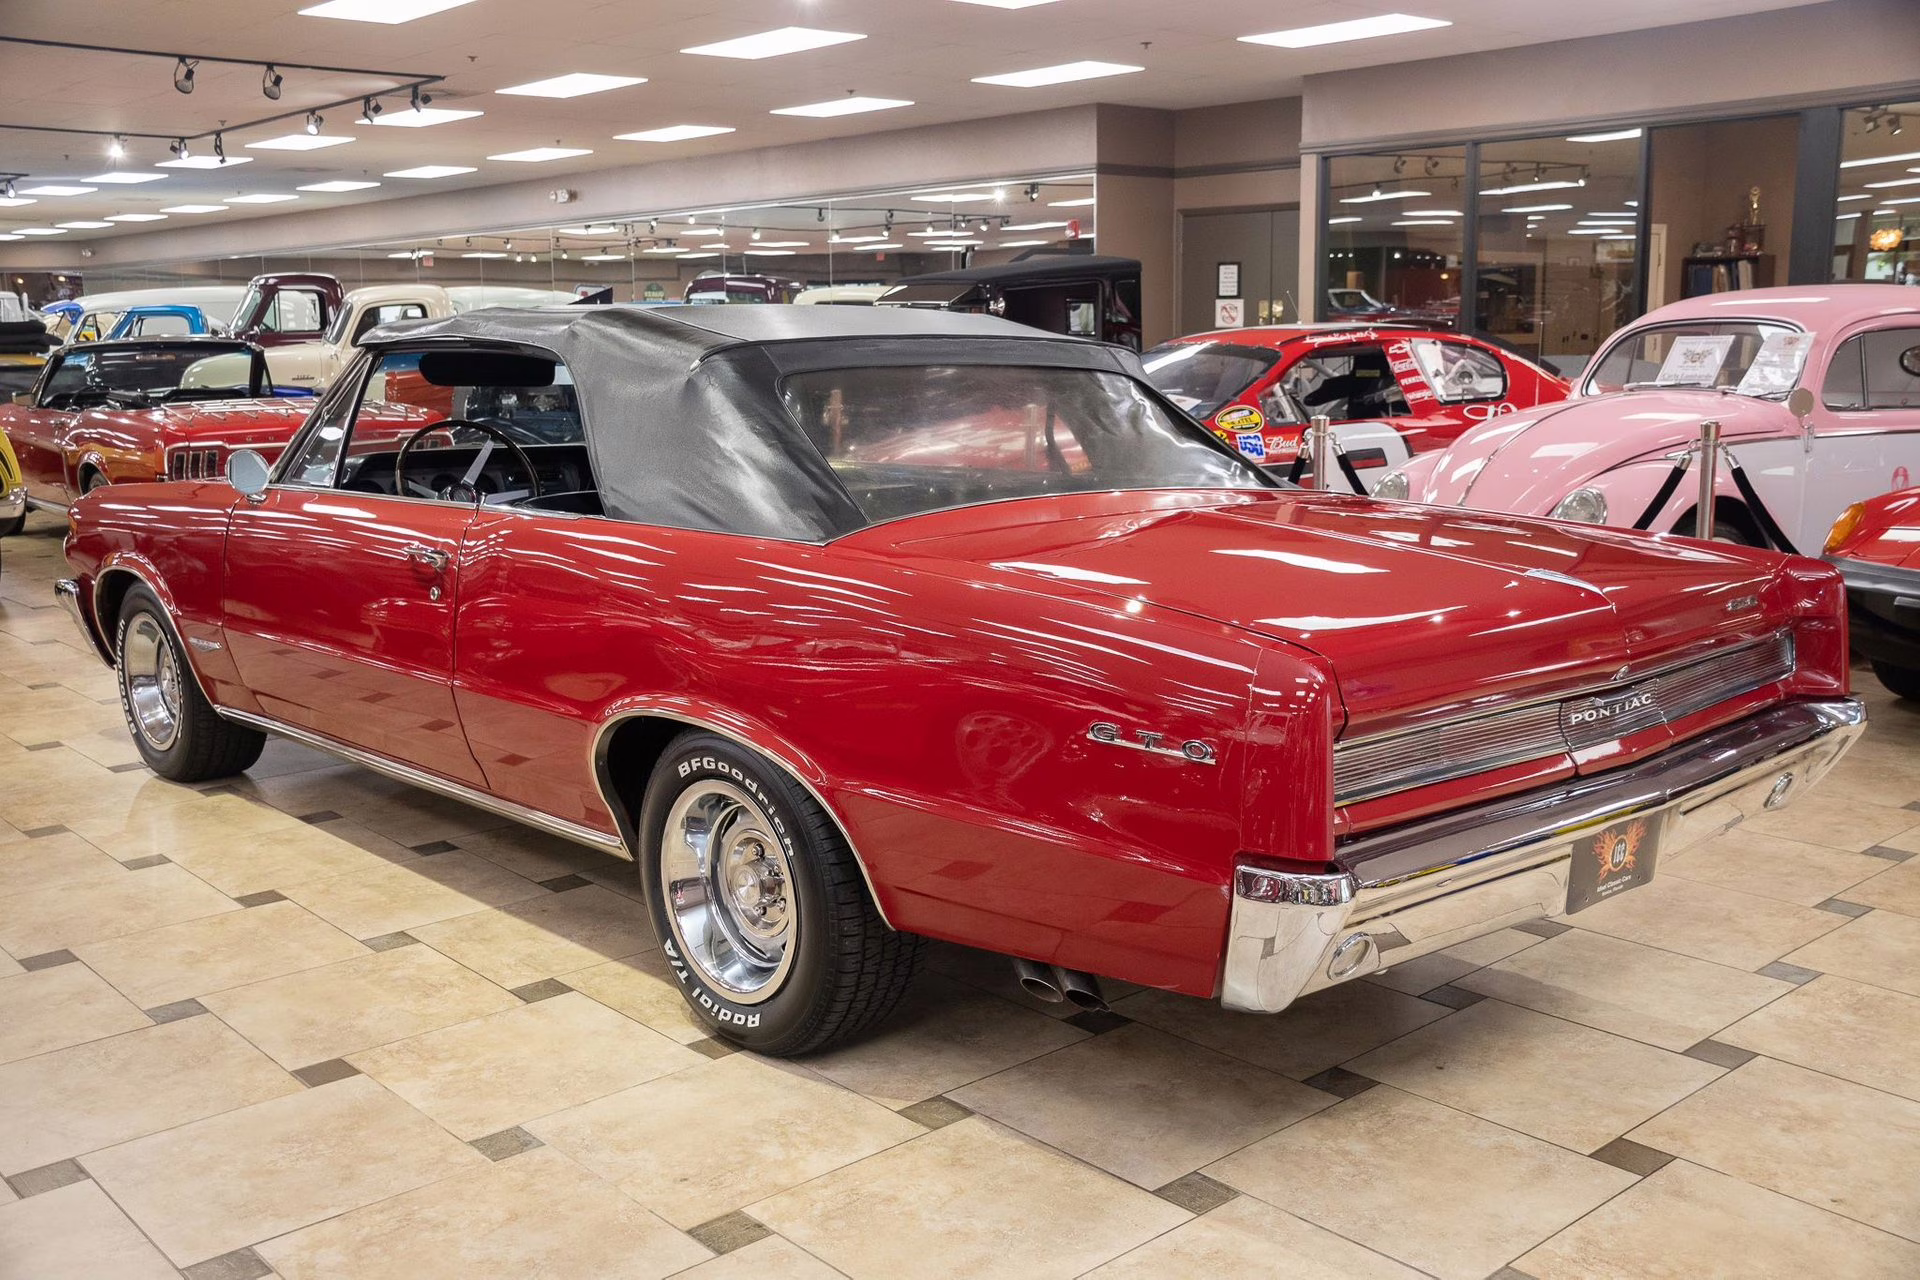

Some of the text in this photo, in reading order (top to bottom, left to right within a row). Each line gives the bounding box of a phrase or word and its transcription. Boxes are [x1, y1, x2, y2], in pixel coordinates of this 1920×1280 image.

[117, 619, 136, 734] BFGoodrich
[1570, 693, 1653, 725] PONTIAC
[1088, 721, 1214, 762] GTO
[677, 757, 795, 857] BFGoodrich
[664, 937, 761, 1028] Radial T/A
